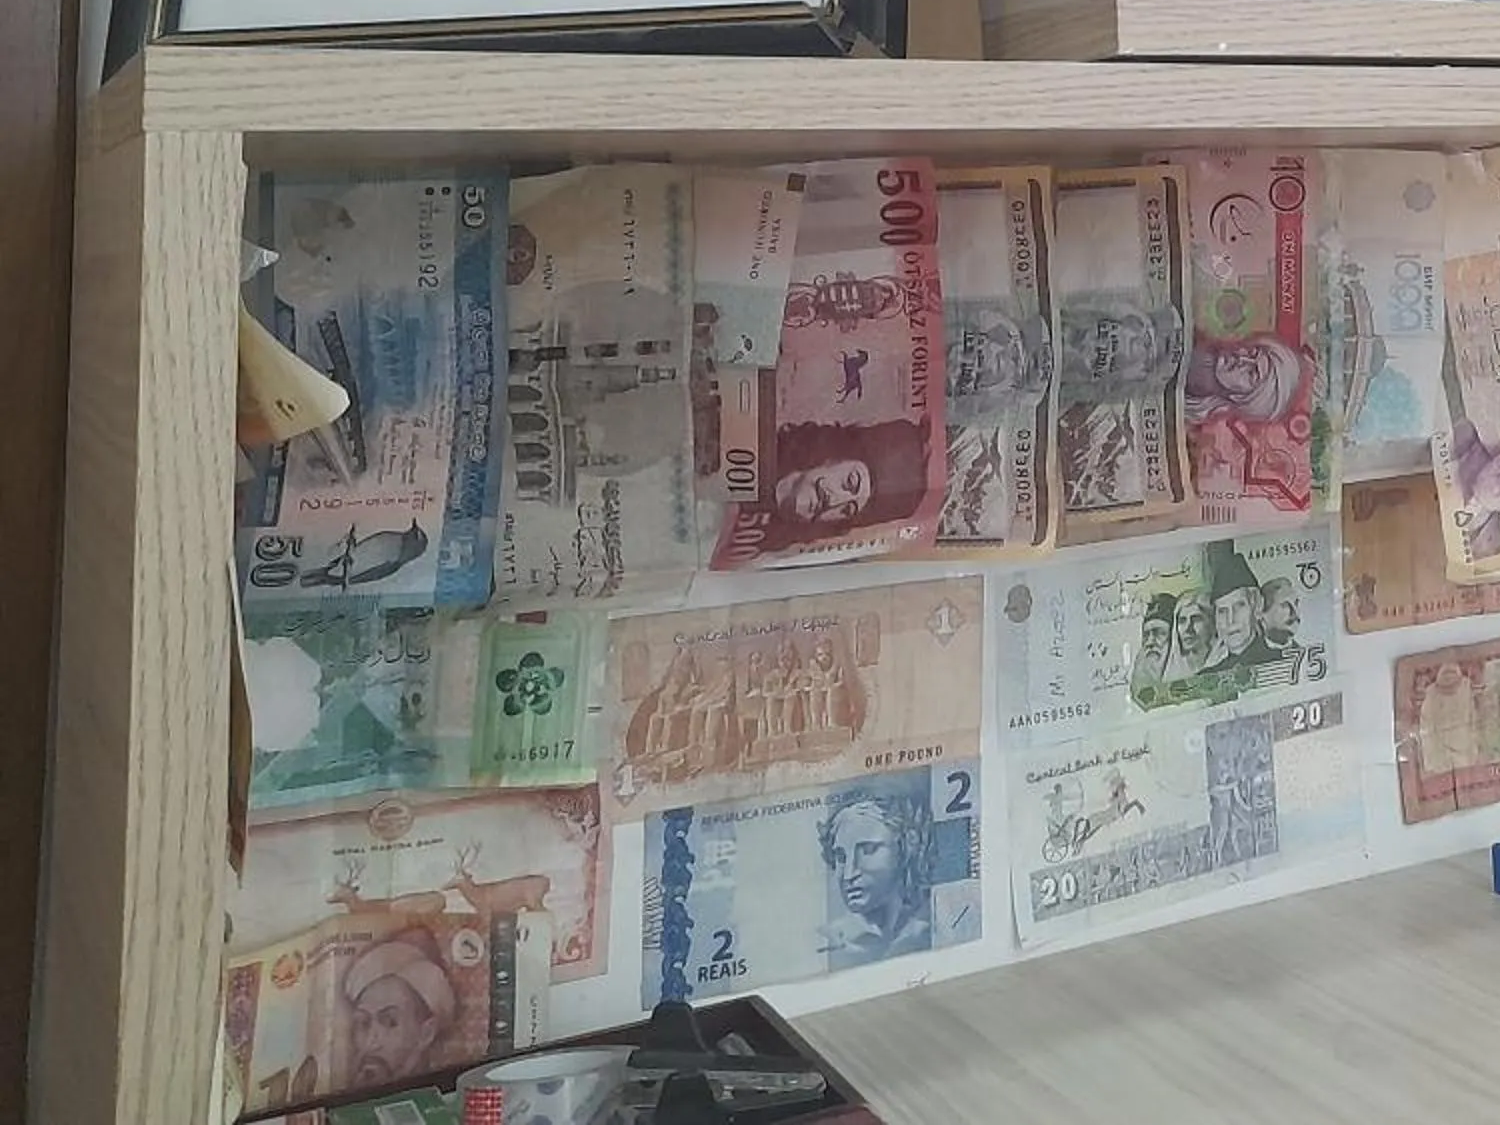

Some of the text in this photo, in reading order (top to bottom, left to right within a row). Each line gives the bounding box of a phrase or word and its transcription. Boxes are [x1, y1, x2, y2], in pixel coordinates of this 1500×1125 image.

[461, 185, 487, 228] 50
[876, 169, 926, 247] 500
[1269, 160, 1307, 212] 10
[908, 335, 928, 413] FORINT
[725, 448, 755, 493] 100
[726, 510, 771, 561] 500
[249, 534, 303, 589] 50
[939, 609, 952, 634] 1
[1282, 642, 1328, 686] 75
[1291, 704, 1323, 731] 20
[865, 745, 944, 769] ONE POUND
[945, 770, 972, 814] 2
[1039, 872, 1079, 907] 20
[711, 930, 734, 962] 2
[697, 958, 748, 983] REAIS
